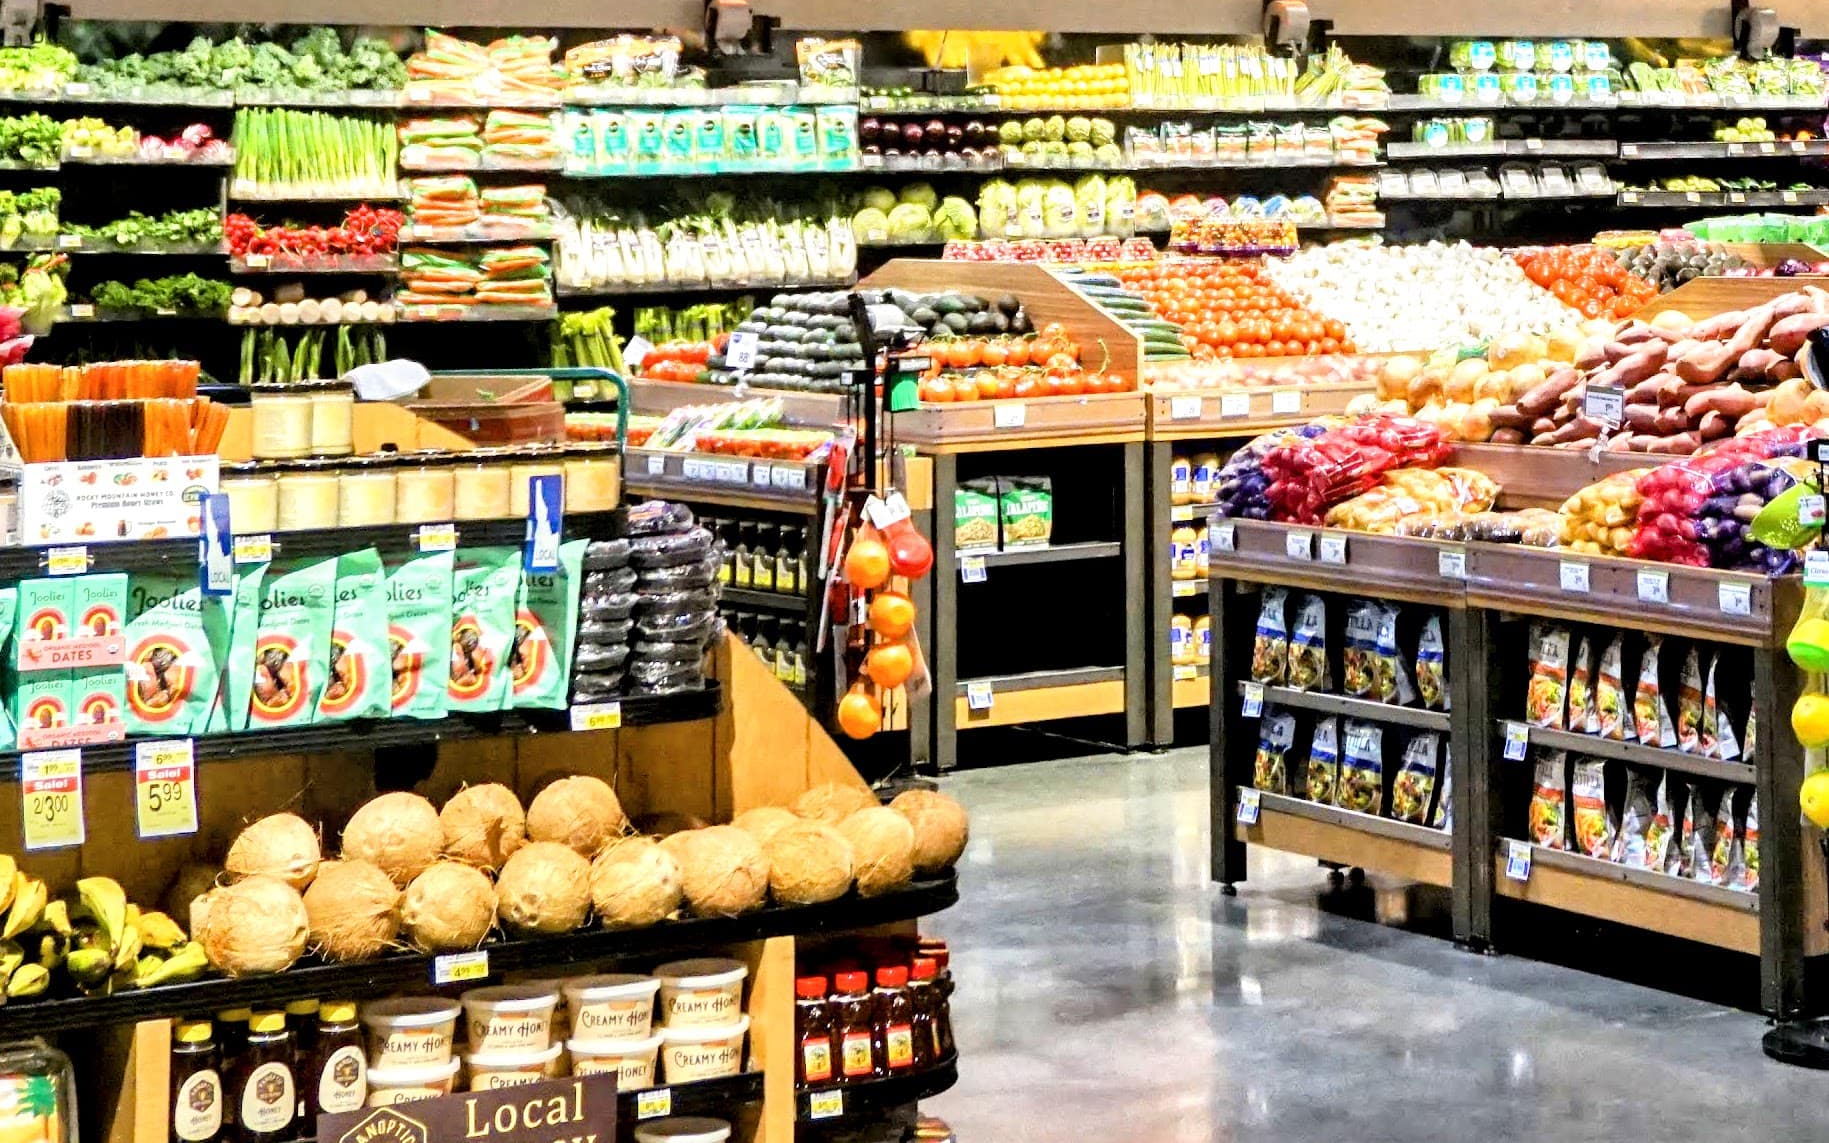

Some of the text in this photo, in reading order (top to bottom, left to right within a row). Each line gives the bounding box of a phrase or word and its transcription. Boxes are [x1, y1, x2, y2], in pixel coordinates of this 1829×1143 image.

[30, 591, 65, 605] Joolies
[83, 587, 118, 602] Joolies
[132, 586, 208, 616] Joolies
[260, 590, 306, 610] olies
[52, 650, 93, 663] DATES
[30, 679, 64, 694] Joolies
[82, 675, 117, 690] Joolies
[148, 768, 180, 780] Sale!
[35, 779, 67, 790] Sale!
[669, 997, 708, 1014] CREAMY
[582, 1011, 623, 1028] CREAMY
[473, 1020, 513, 1038] CREAMY
[674, 1050, 715, 1067] CREAMY
[617, 1063, 648, 1081] HONEY
[465, 1082, 585, 1138] Local
